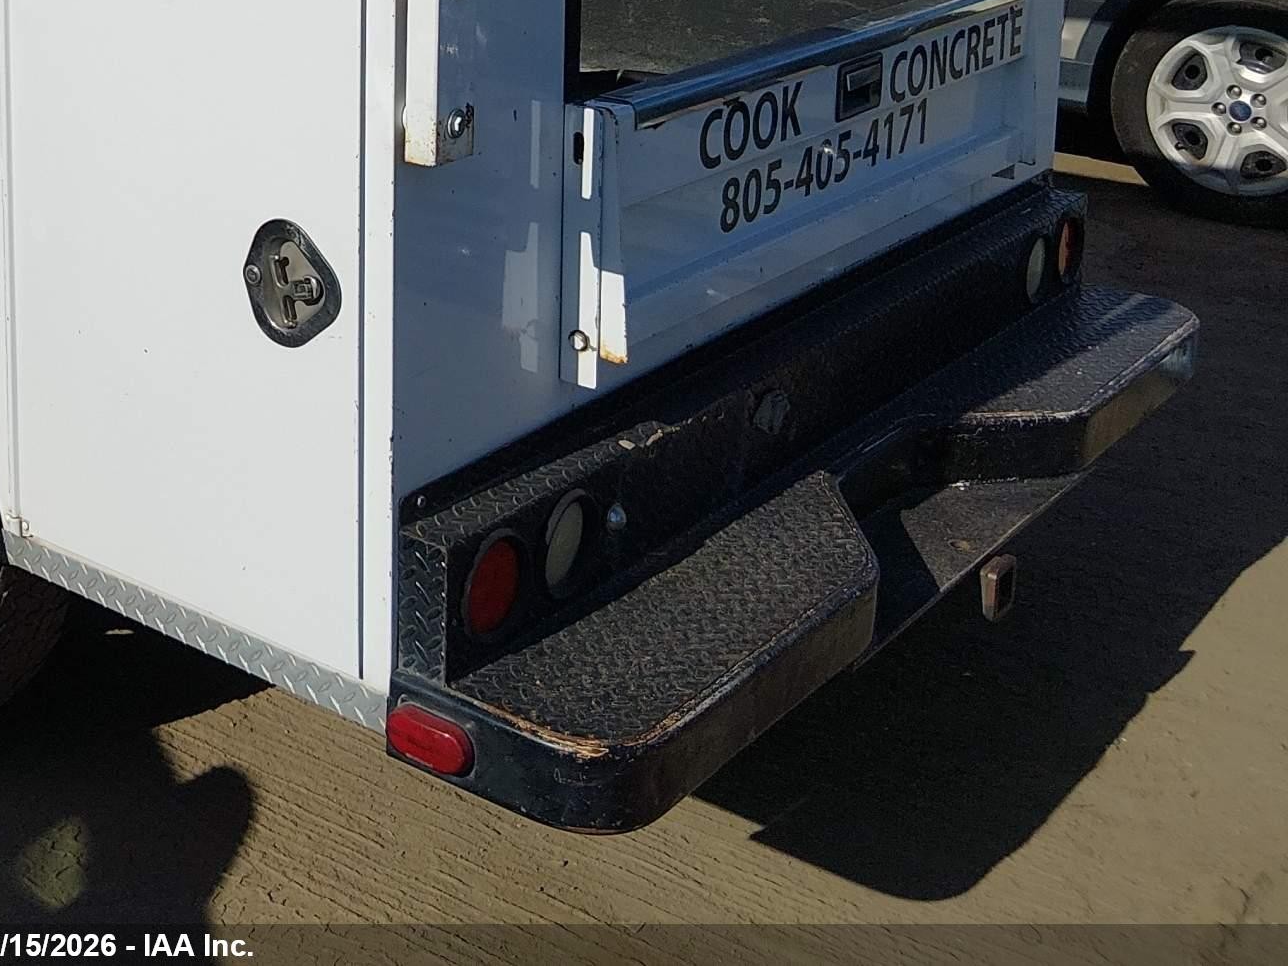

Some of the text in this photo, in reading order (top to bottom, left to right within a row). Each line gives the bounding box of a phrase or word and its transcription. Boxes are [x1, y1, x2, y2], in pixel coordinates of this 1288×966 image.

[699, 6, 1024, 170] COOK CONCRETE
[720, 97, 928, 234] 805-405-4171
